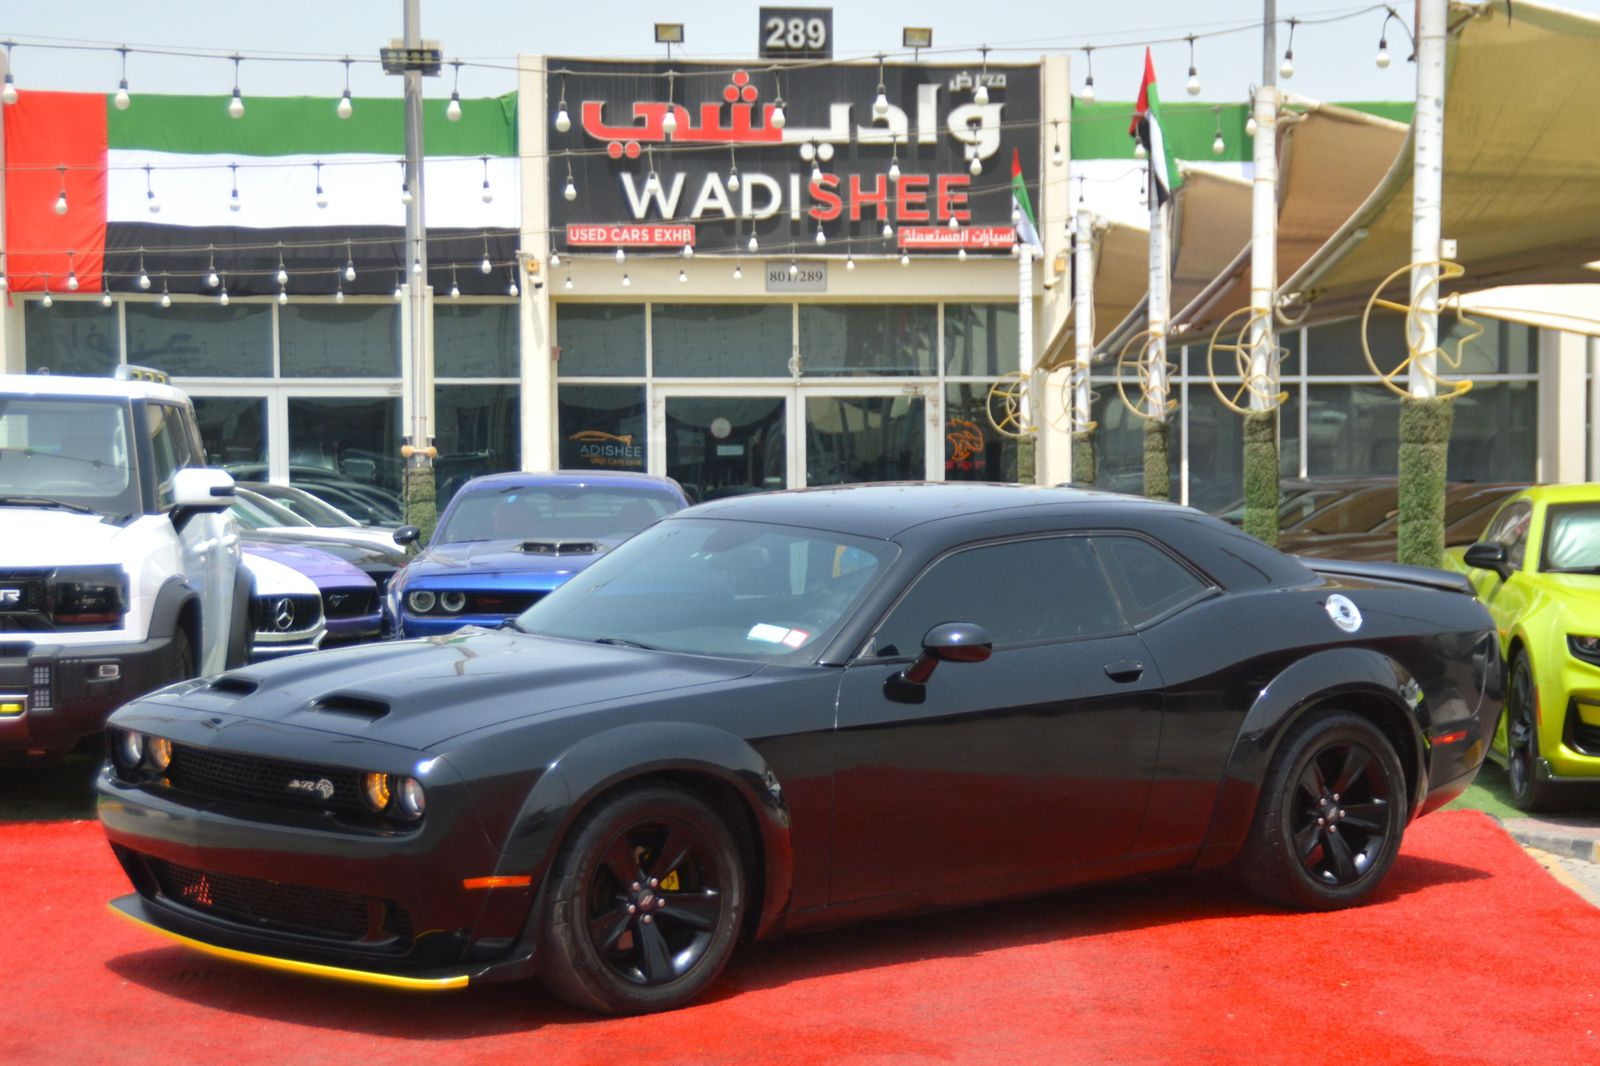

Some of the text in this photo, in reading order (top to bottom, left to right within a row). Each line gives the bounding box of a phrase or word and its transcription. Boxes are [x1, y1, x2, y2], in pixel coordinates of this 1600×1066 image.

[765, 18, 826, 48] 289
[569, 228, 607, 241] USED
[611, 228, 649, 241] CARS
